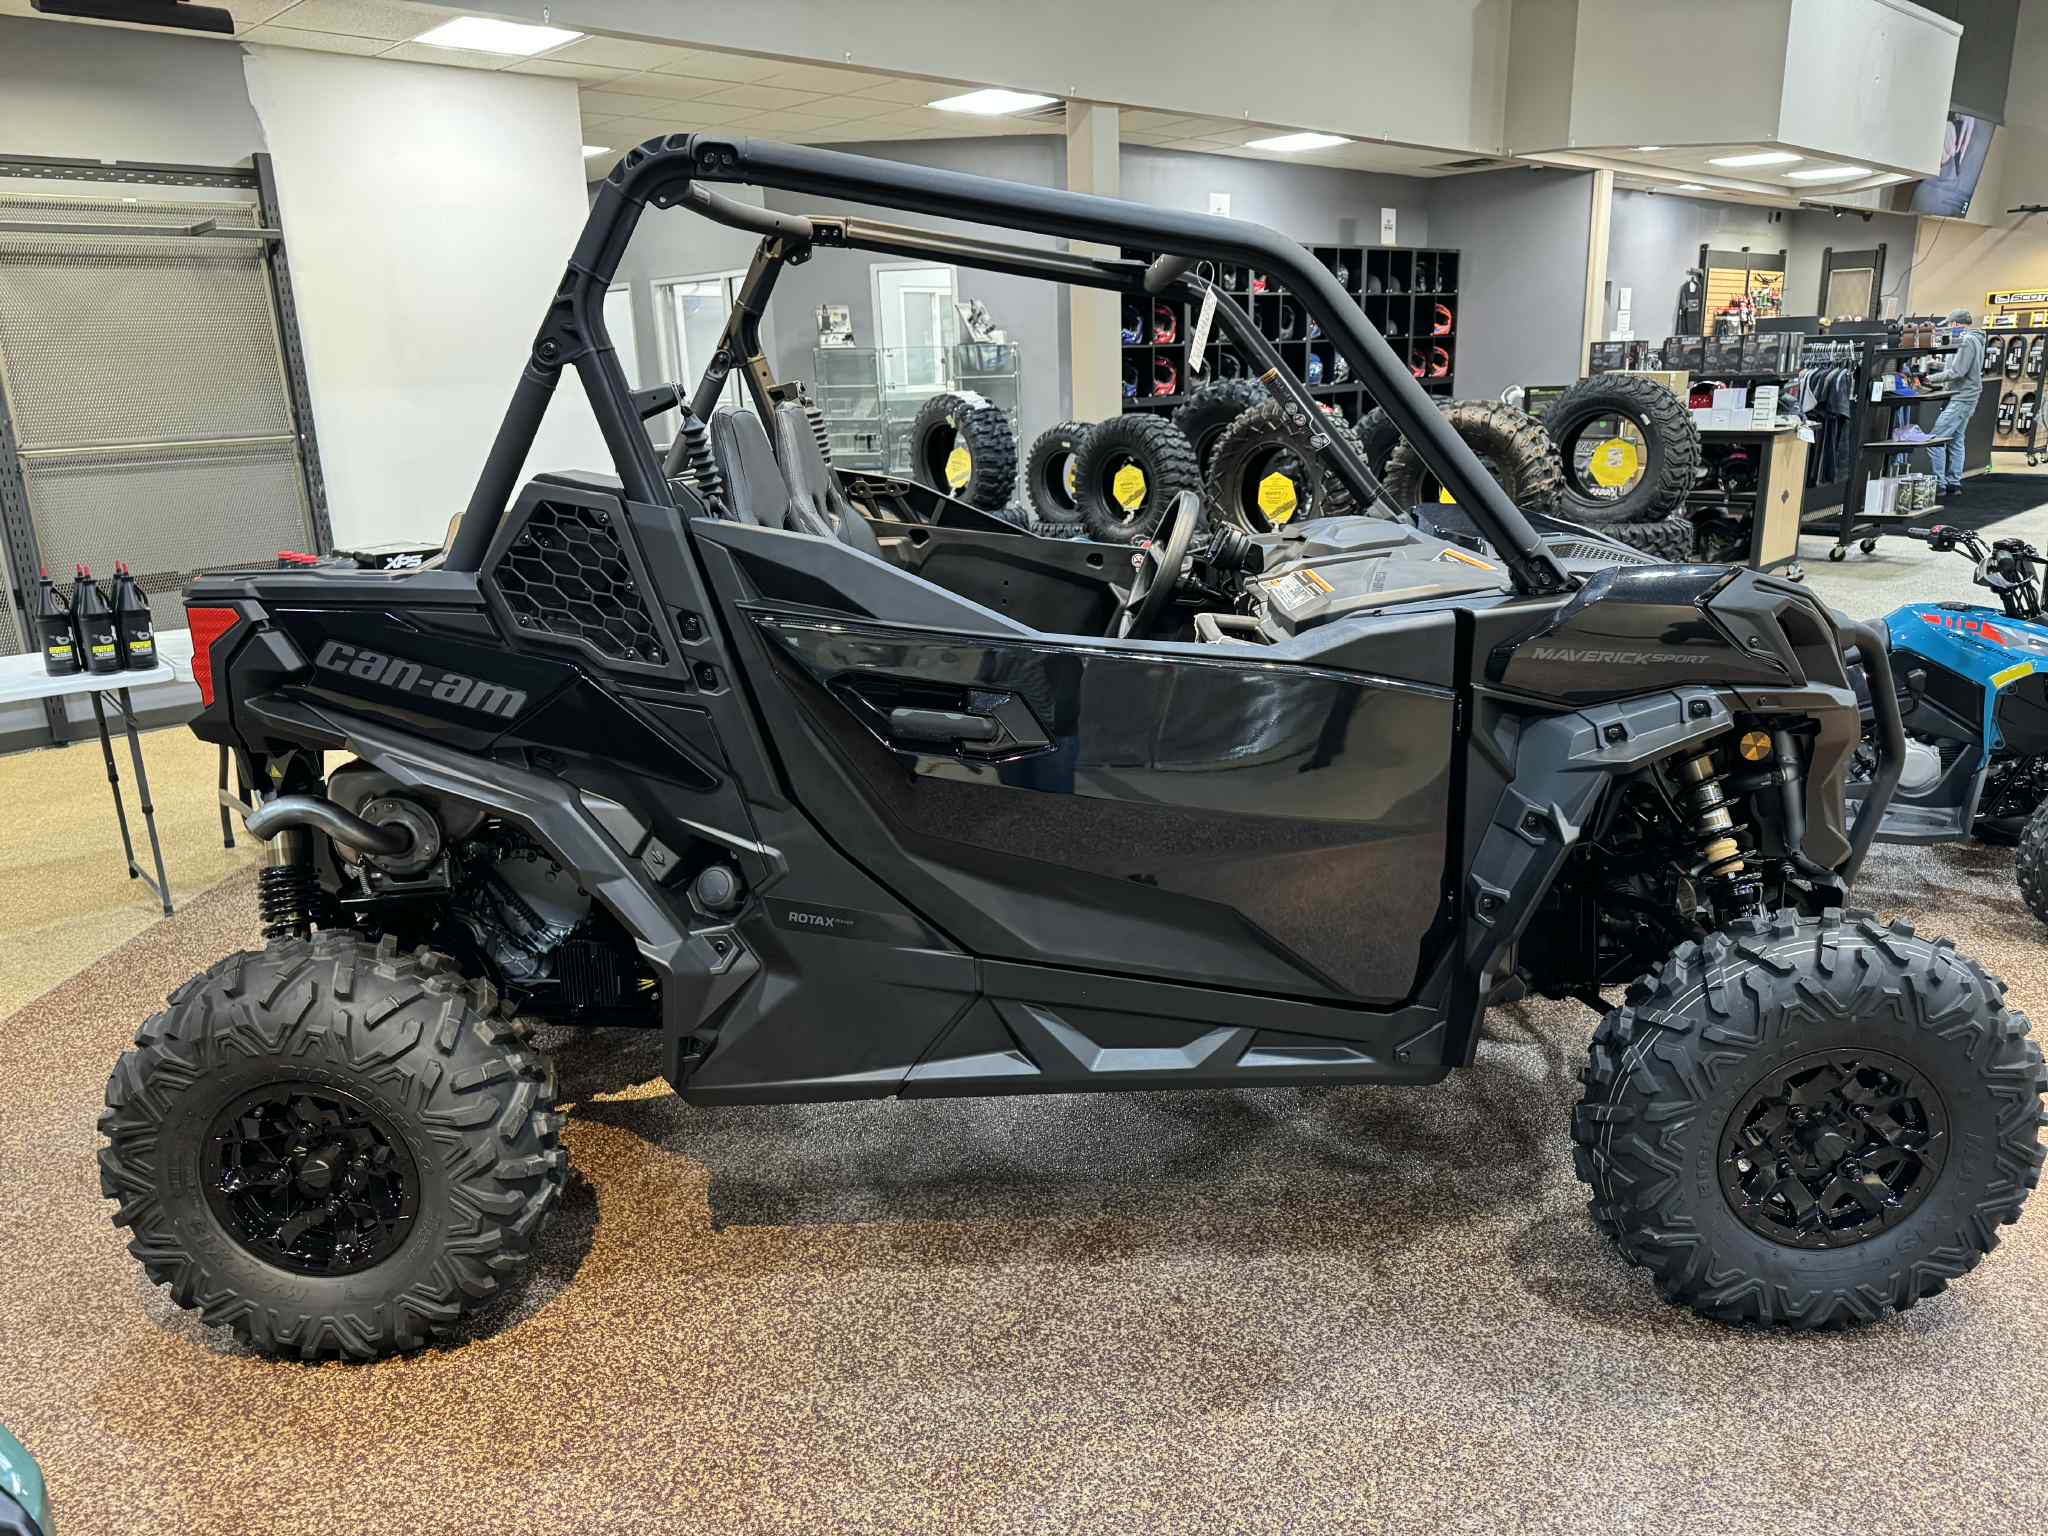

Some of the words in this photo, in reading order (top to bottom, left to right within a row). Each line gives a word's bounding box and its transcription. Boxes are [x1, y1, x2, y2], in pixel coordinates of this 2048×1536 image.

[384, 554, 423, 569] XPS
[1532, 648, 1651, 665] MAVERICK
[1651, 653, 1710, 664] SPORT
[316, 639, 527, 718] can-am
[788, 911, 834, 927] ROTAX
